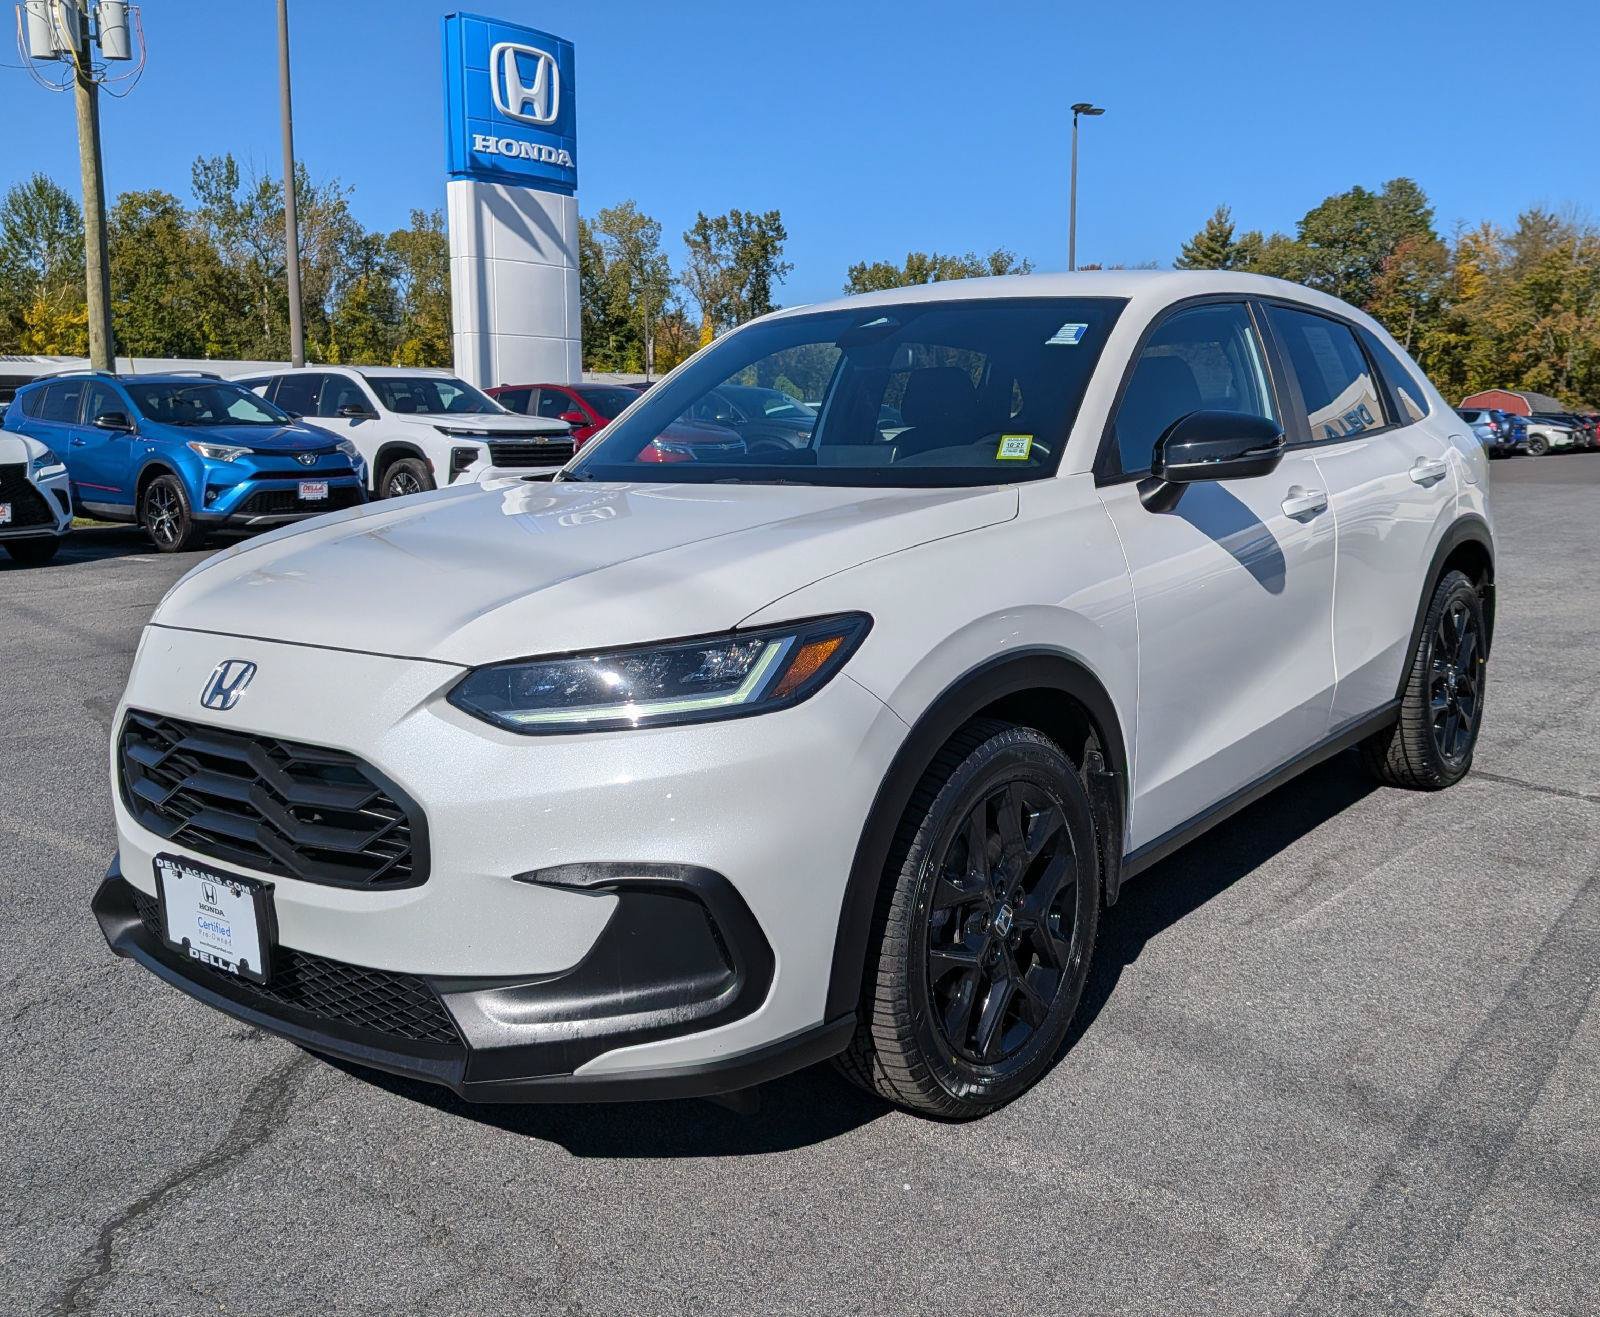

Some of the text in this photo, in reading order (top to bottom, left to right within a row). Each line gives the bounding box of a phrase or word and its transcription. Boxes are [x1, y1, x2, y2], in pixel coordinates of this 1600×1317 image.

[472, 134, 575, 168] HONDA
[156, 858, 251, 895] DELLACARS.COM
[199, 902, 226, 917] HONDA
[197, 916, 231, 937] Certified
[189, 947, 239, 975] DELLA
